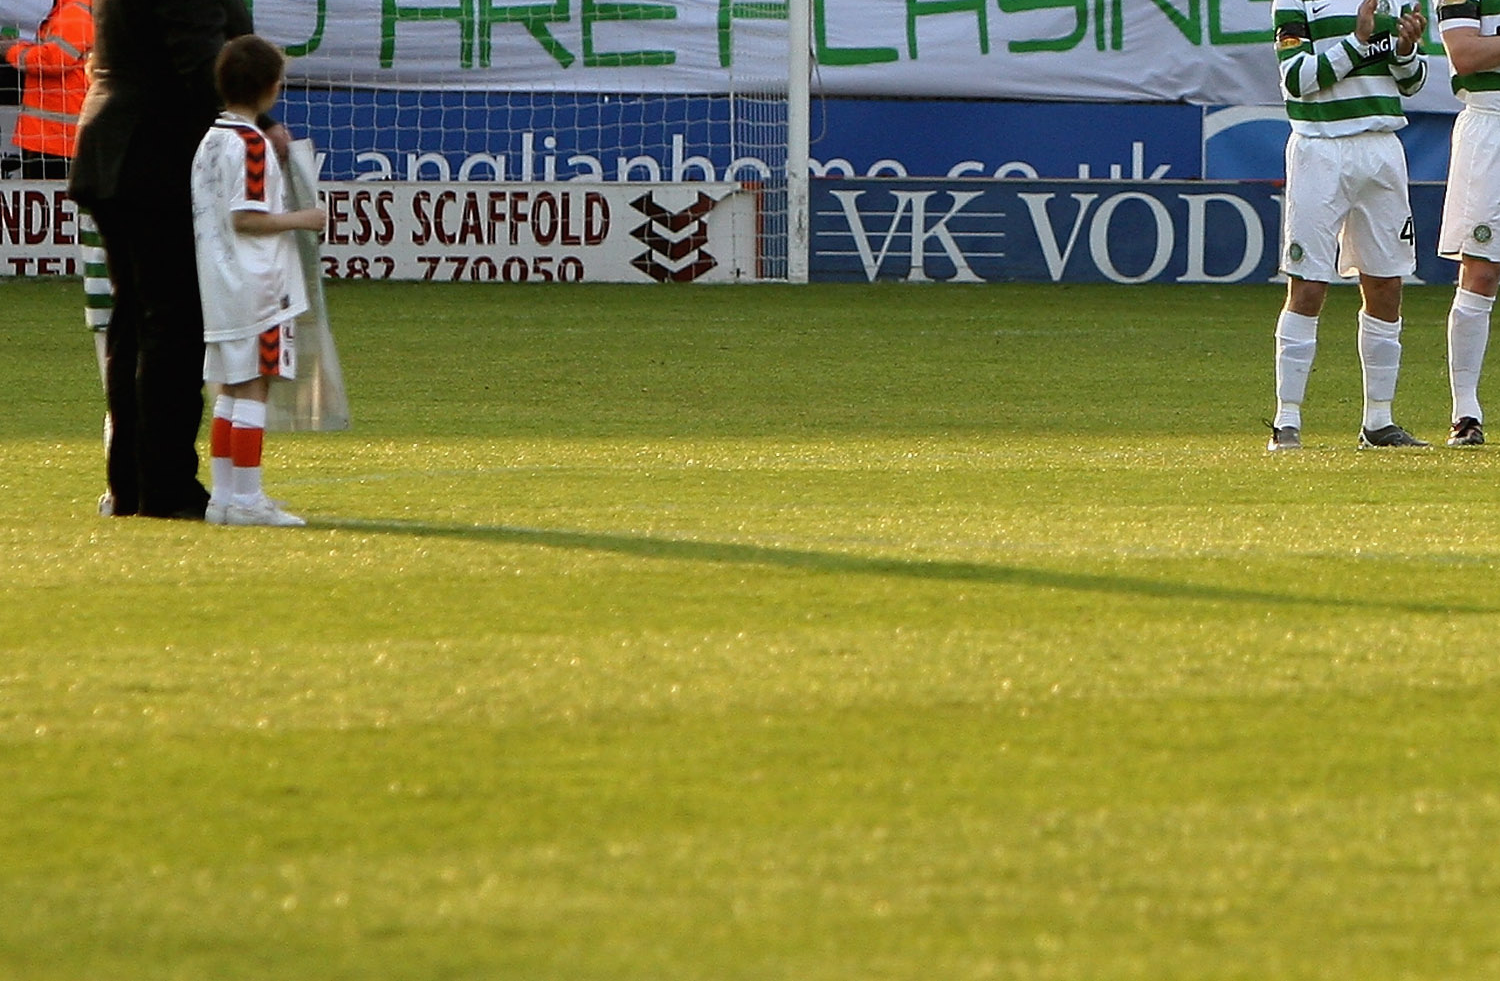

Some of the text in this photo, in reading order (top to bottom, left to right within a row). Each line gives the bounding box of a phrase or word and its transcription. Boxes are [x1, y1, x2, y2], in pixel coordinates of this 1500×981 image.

[318, 190, 395, 246] ESS
[411, 190, 611, 247] SCAFFOLD
[828, 189, 987, 283] VK
[416, 255, 585, 283] 770050
